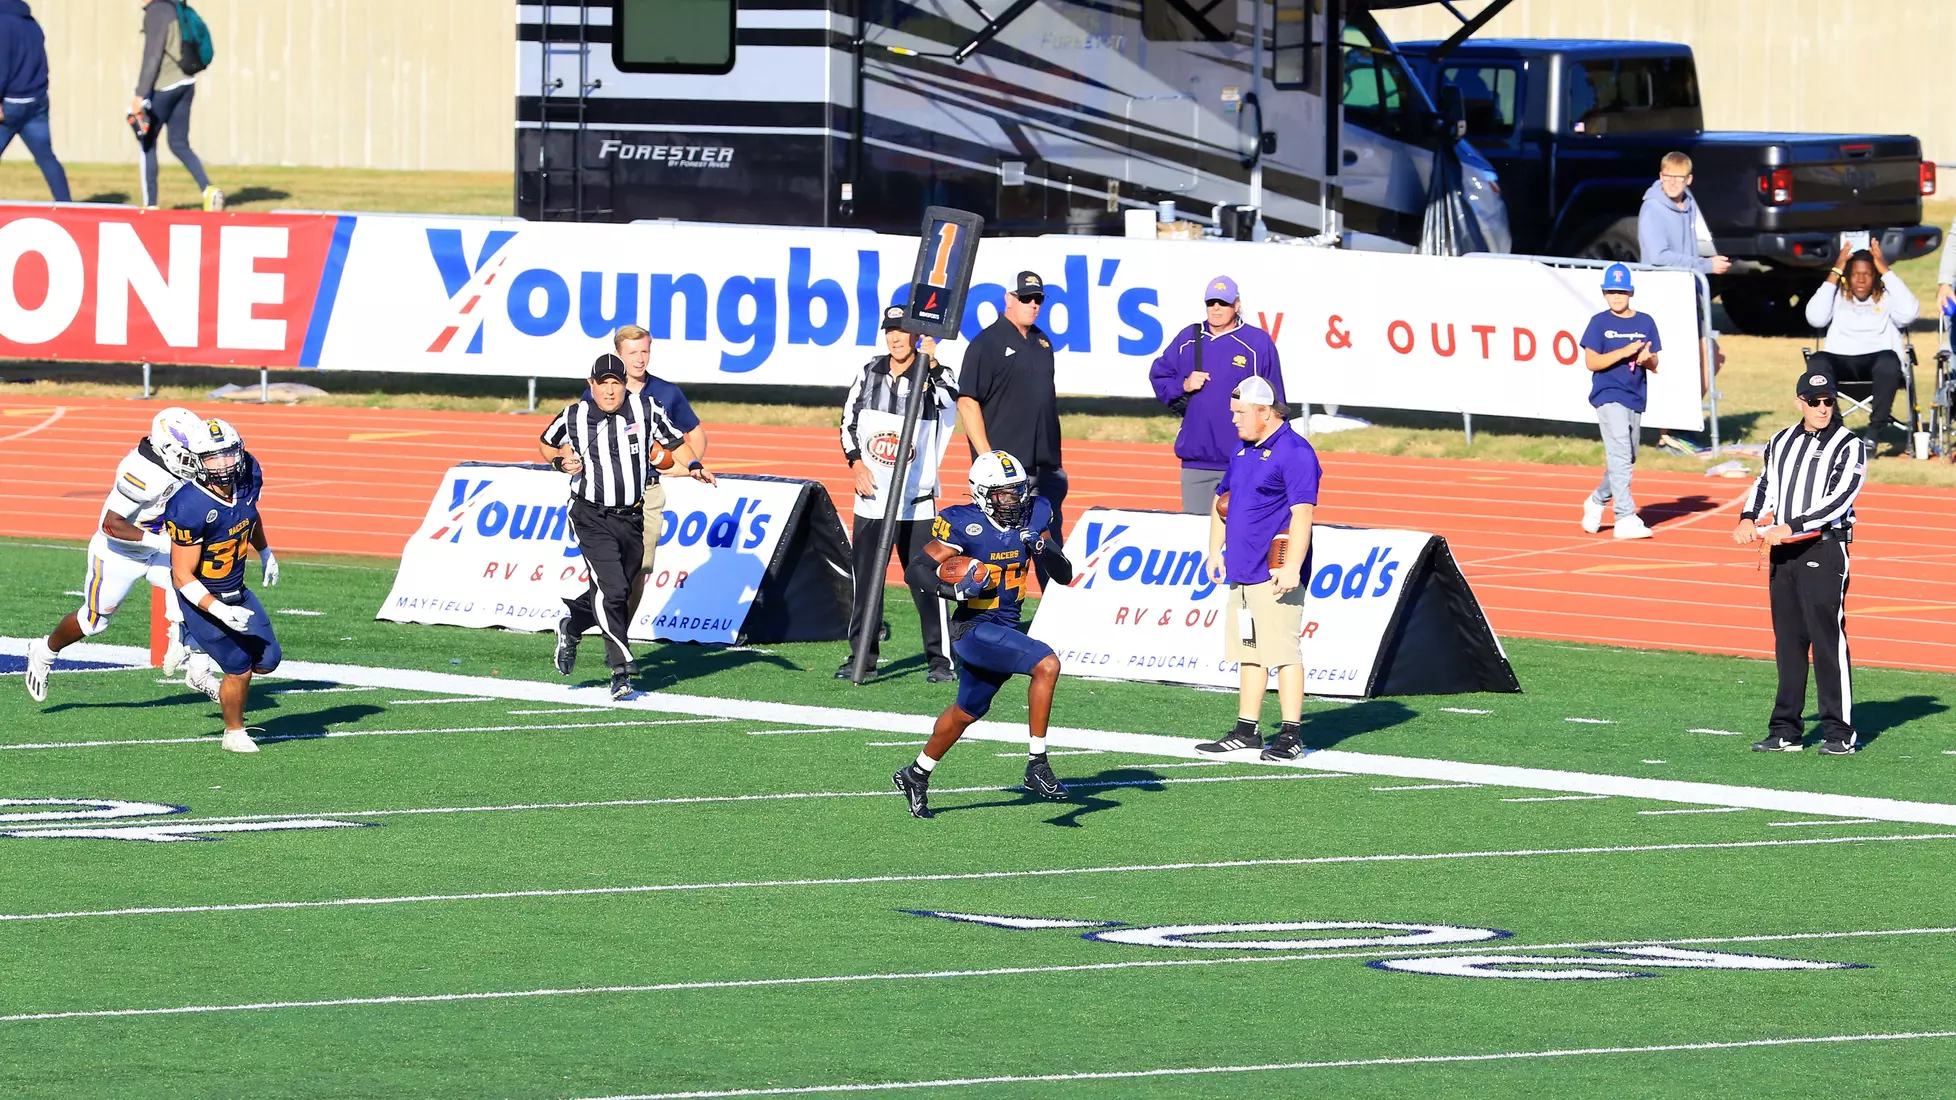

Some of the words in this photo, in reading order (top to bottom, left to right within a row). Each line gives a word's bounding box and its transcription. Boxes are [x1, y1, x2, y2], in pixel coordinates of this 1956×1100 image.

[599, 140, 735, 161] FORESTER
[928, 222, 958, 288] 1
[1613, 270, 1624, 283] T
[426, 229, 1160, 372] Youngblod's
[1257, 311, 1284, 344] V
[1325, 314, 1352, 349] &
[1387, 319, 1658, 373] OUTDO
[631, 443, 640, 455] H
[228, 517, 250, 537] RACERS
[430, 479, 772, 558] Younood's
[931, 515, 952, 541] 24
[990, 549, 1020, 561] RACERS
[1067, 522, 1399, 601] Youngod's
[482, 561, 514, 581] RV
[530, 564, 545, 582] &
[560, 565, 690, 590] OUOR
[396, 596, 475, 614] MAYFIELD
[640, 613, 734, 632] GIRARDEAU
[1115, 606, 1149, 627] RV
[1158, 608, 1172, 626] &
[1057, 649, 1111, 665] YFIELD
[1127, 654, 1198, 670] PADUCAH
[1218, 660, 1240, 675] CA
[1267, 666, 1359, 682] GRDEAU
